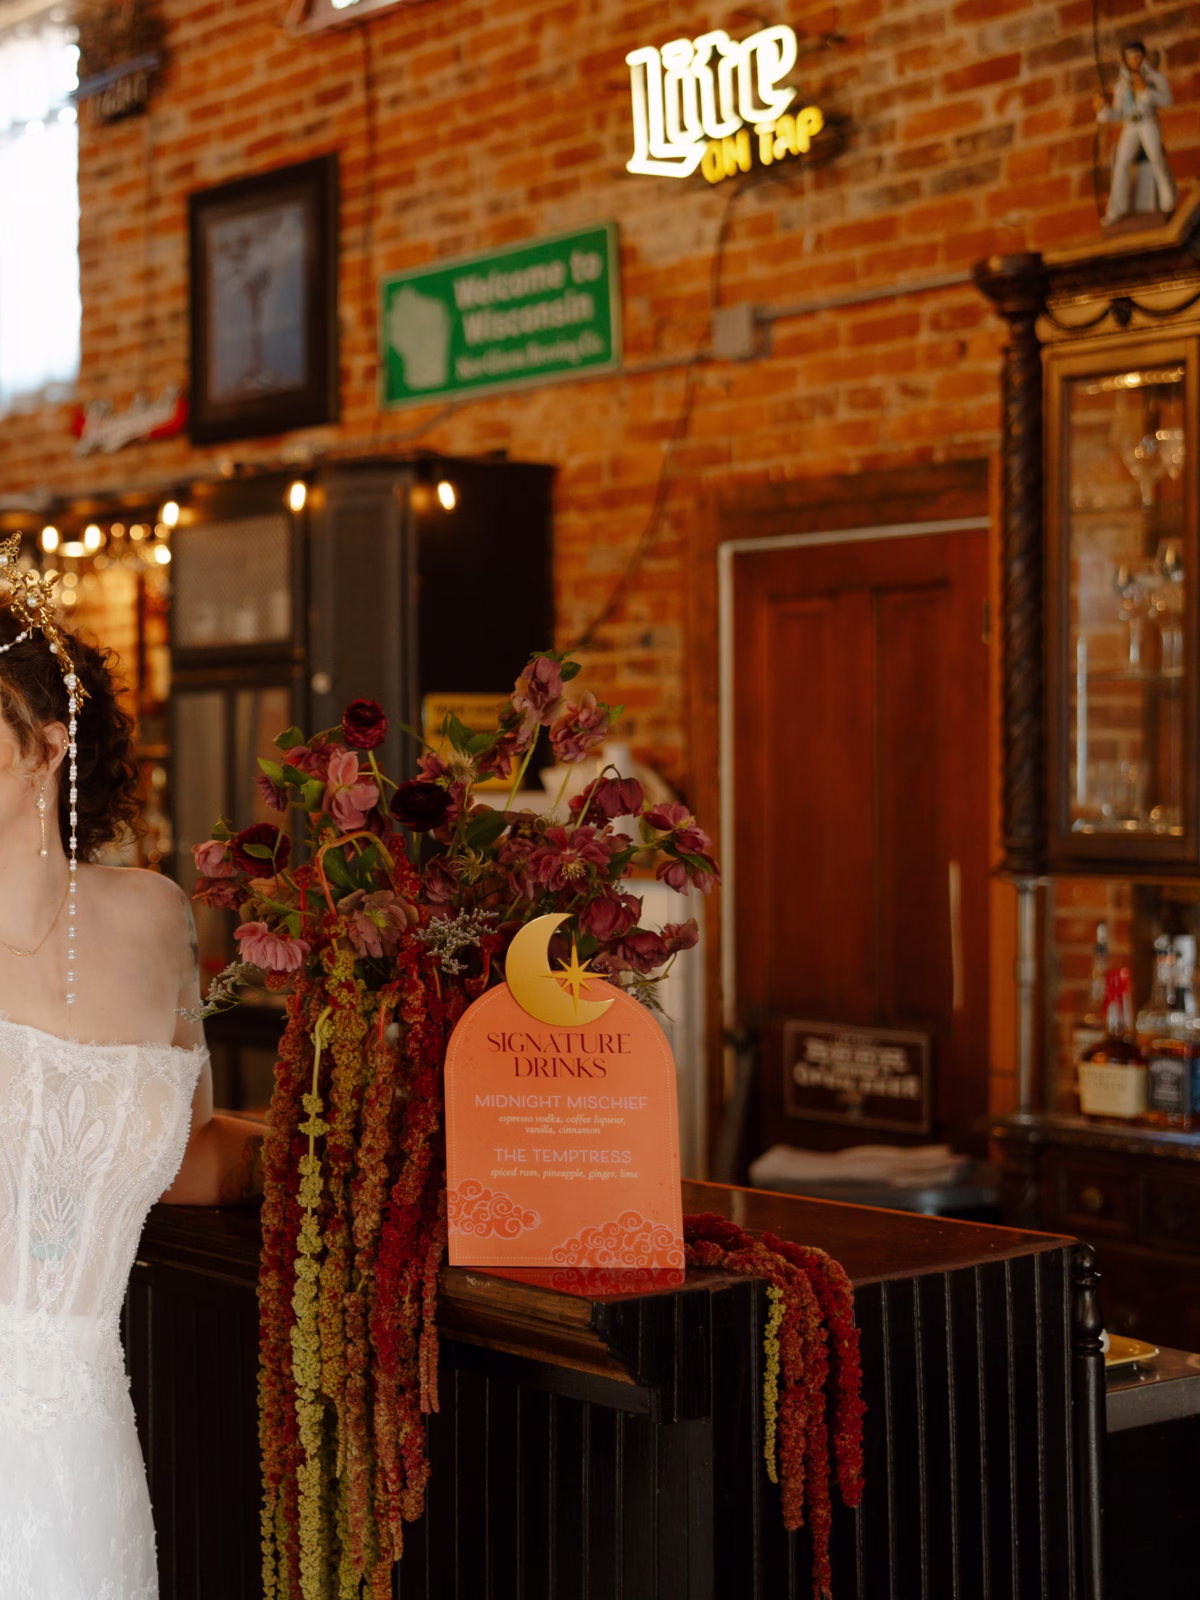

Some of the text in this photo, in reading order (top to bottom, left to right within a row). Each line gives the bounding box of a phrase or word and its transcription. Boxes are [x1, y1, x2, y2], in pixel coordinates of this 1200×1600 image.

[626, 25, 797, 178] Lite
[701, 106, 823, 183] ON TAP
[454, 250, 601, 310] Welcome to
[463, 289, 594, 345] Wisconsin
[487, 1032, 631, 1054] SIGNATURE
[514, 1057, 607, 1078] DRINKS
[475, 1094, 648, 1110] MIDNIGHT MISCHIEF
[499, 1113, 626, 1126] espresso vodka, coffee liqueur,
[525, 1124, 600, 1134] vanilla, cinnamon
[494, 1148, 632, 1164] THE TEMPTRESS
[490, 1167, 639, 1181] spiced rum, pineapple, ginger, lime
